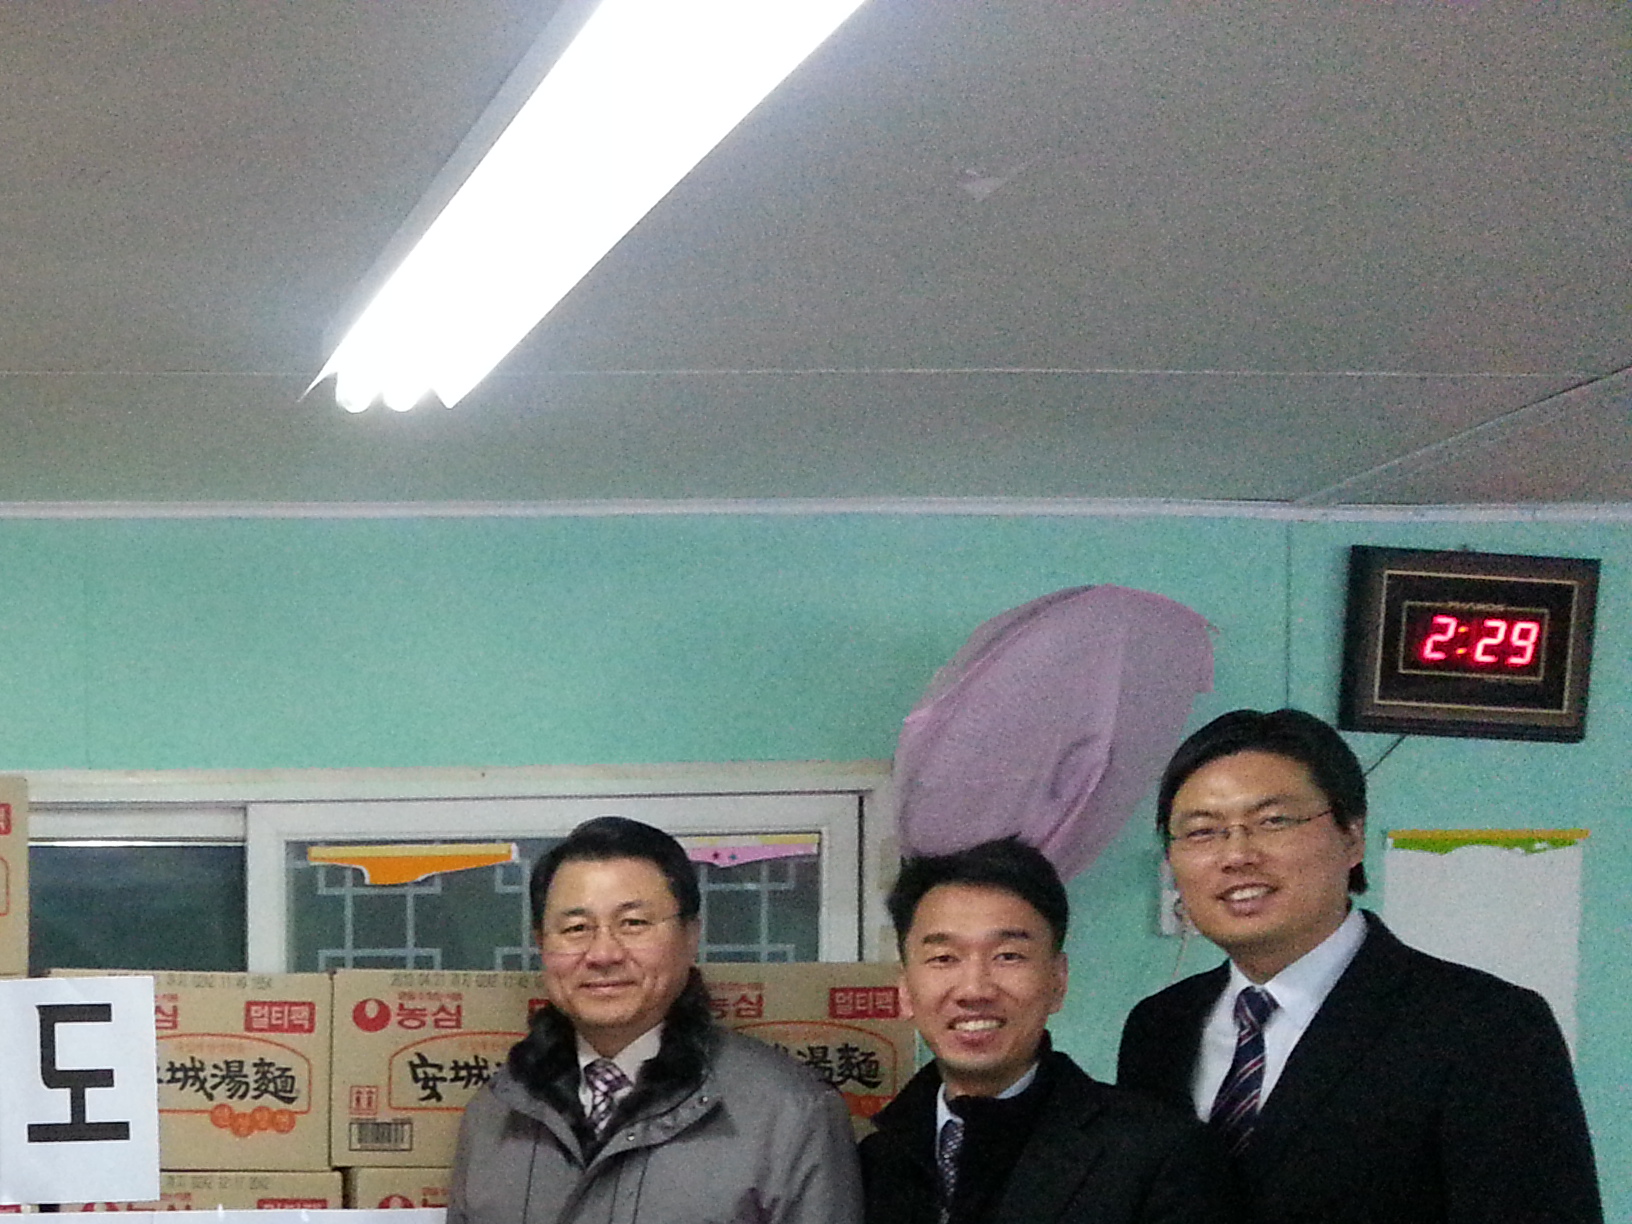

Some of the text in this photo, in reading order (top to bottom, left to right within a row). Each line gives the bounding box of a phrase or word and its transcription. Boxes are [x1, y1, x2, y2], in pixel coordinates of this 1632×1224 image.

[1422, 615, 1540, 665] 2:29
[249, 1004, 311, 1030] 멀티팩
[396, 1002, 463, 1029] 농심
[157, 1056, 299, 1104] 城湯麵
